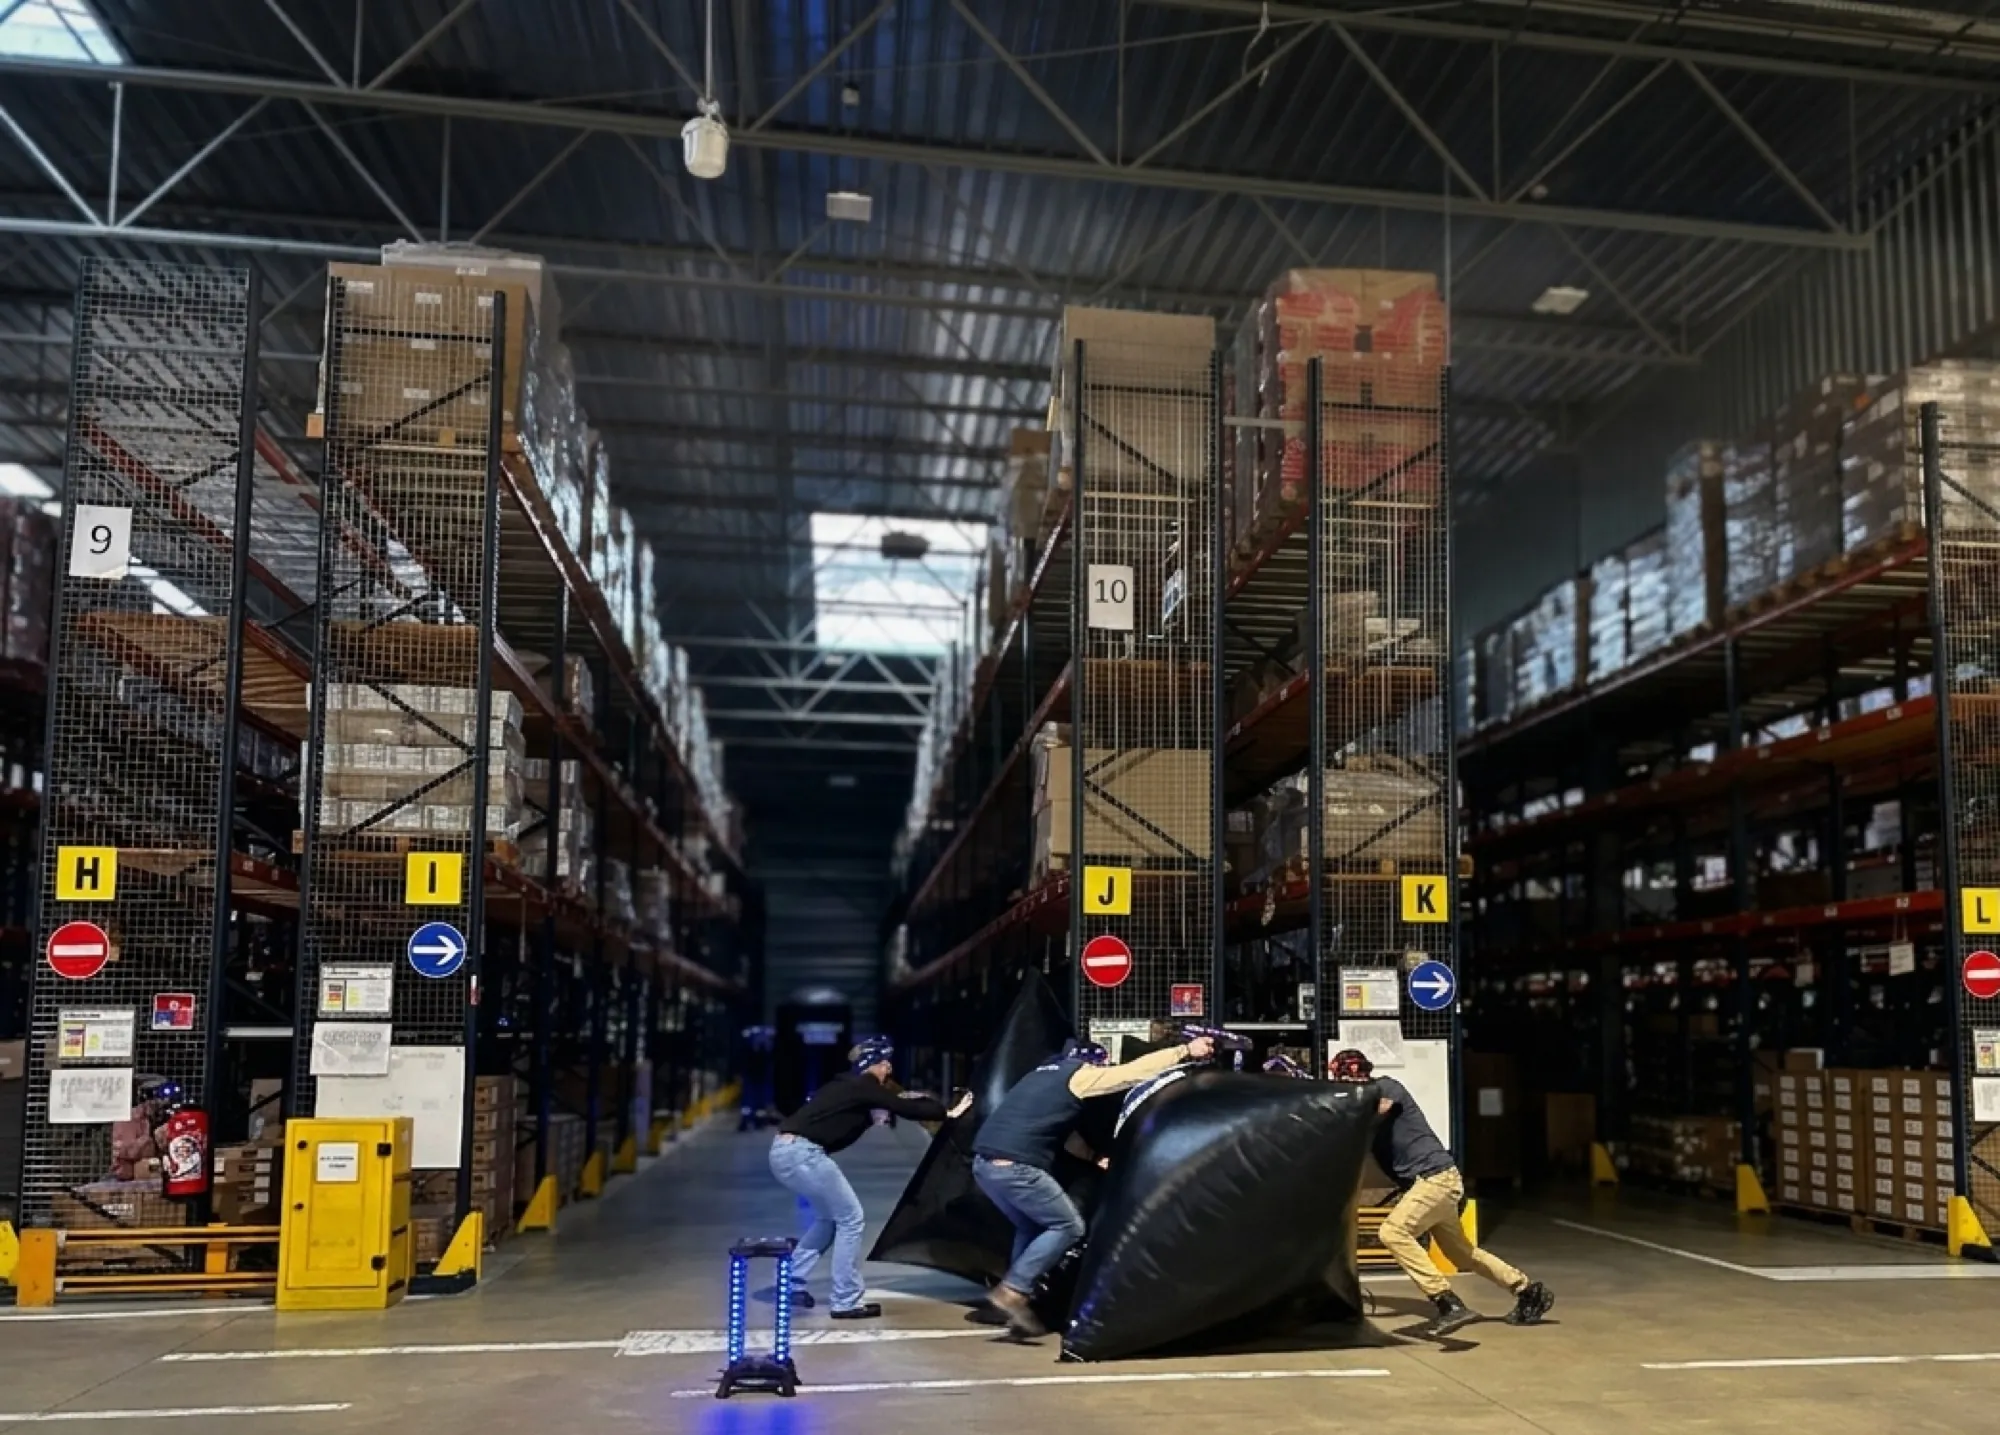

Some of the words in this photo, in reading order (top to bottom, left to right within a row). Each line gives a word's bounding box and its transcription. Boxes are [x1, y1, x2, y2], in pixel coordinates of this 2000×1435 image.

[90, 525, 112, 554] 9
[1095, 579, 1128, 604] 10
[75, 856, 100, 891] H
[428, 861, 437, 894] I
[1098, 875, 1115, 906] J
[1417, 883, 1436, 914] K
[1976, 896, 1991, 924] L
